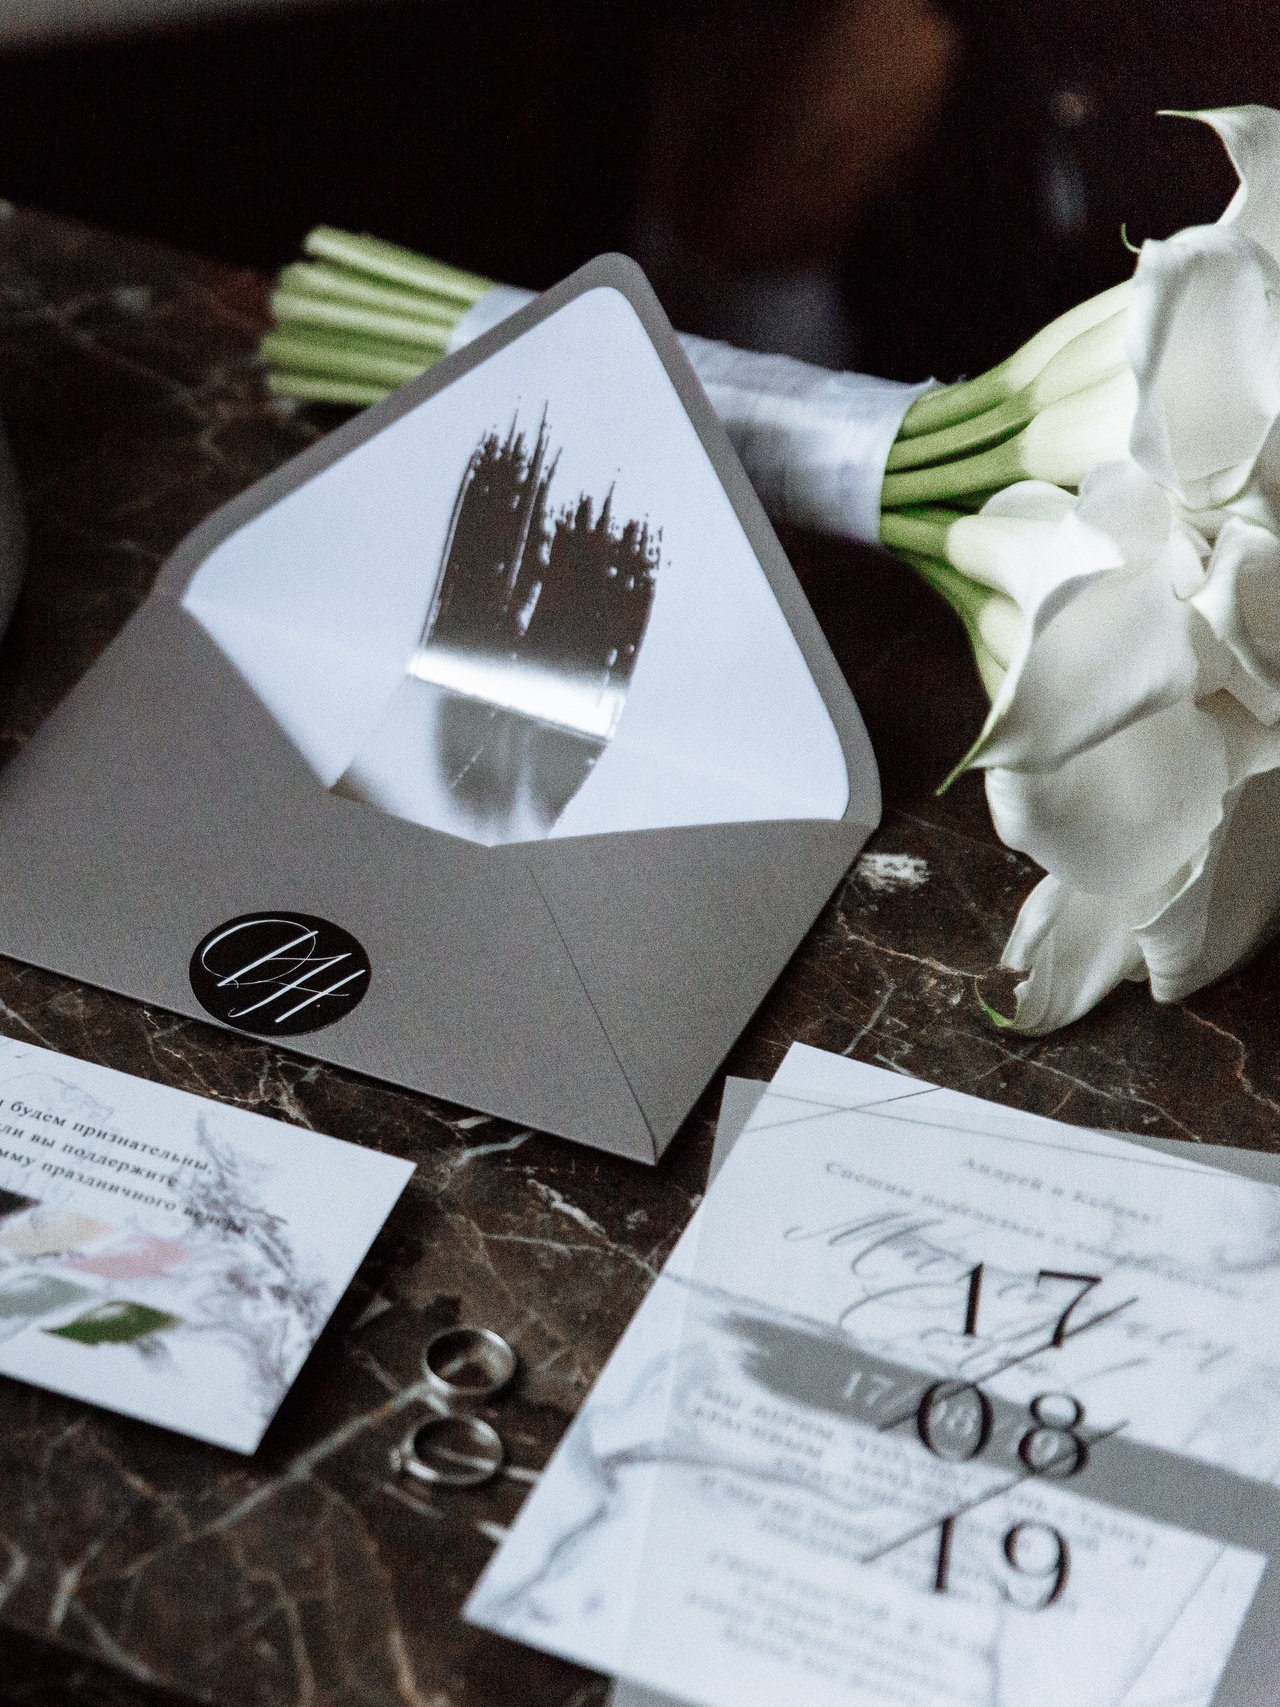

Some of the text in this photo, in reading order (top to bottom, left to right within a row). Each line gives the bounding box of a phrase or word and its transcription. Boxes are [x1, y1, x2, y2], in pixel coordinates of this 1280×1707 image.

[10, 1100, 66, 1127] будем
[31, 1132, 56, 1149] вы
[61, 1142, 179, 1188] поддержите
[41, 1162, 177, 1211] праздничного
[962, 1261, 1103, 1348] 17
[917, 1378, 1090, 1480] 08
[934, 1514, 1073, 1611] 19
